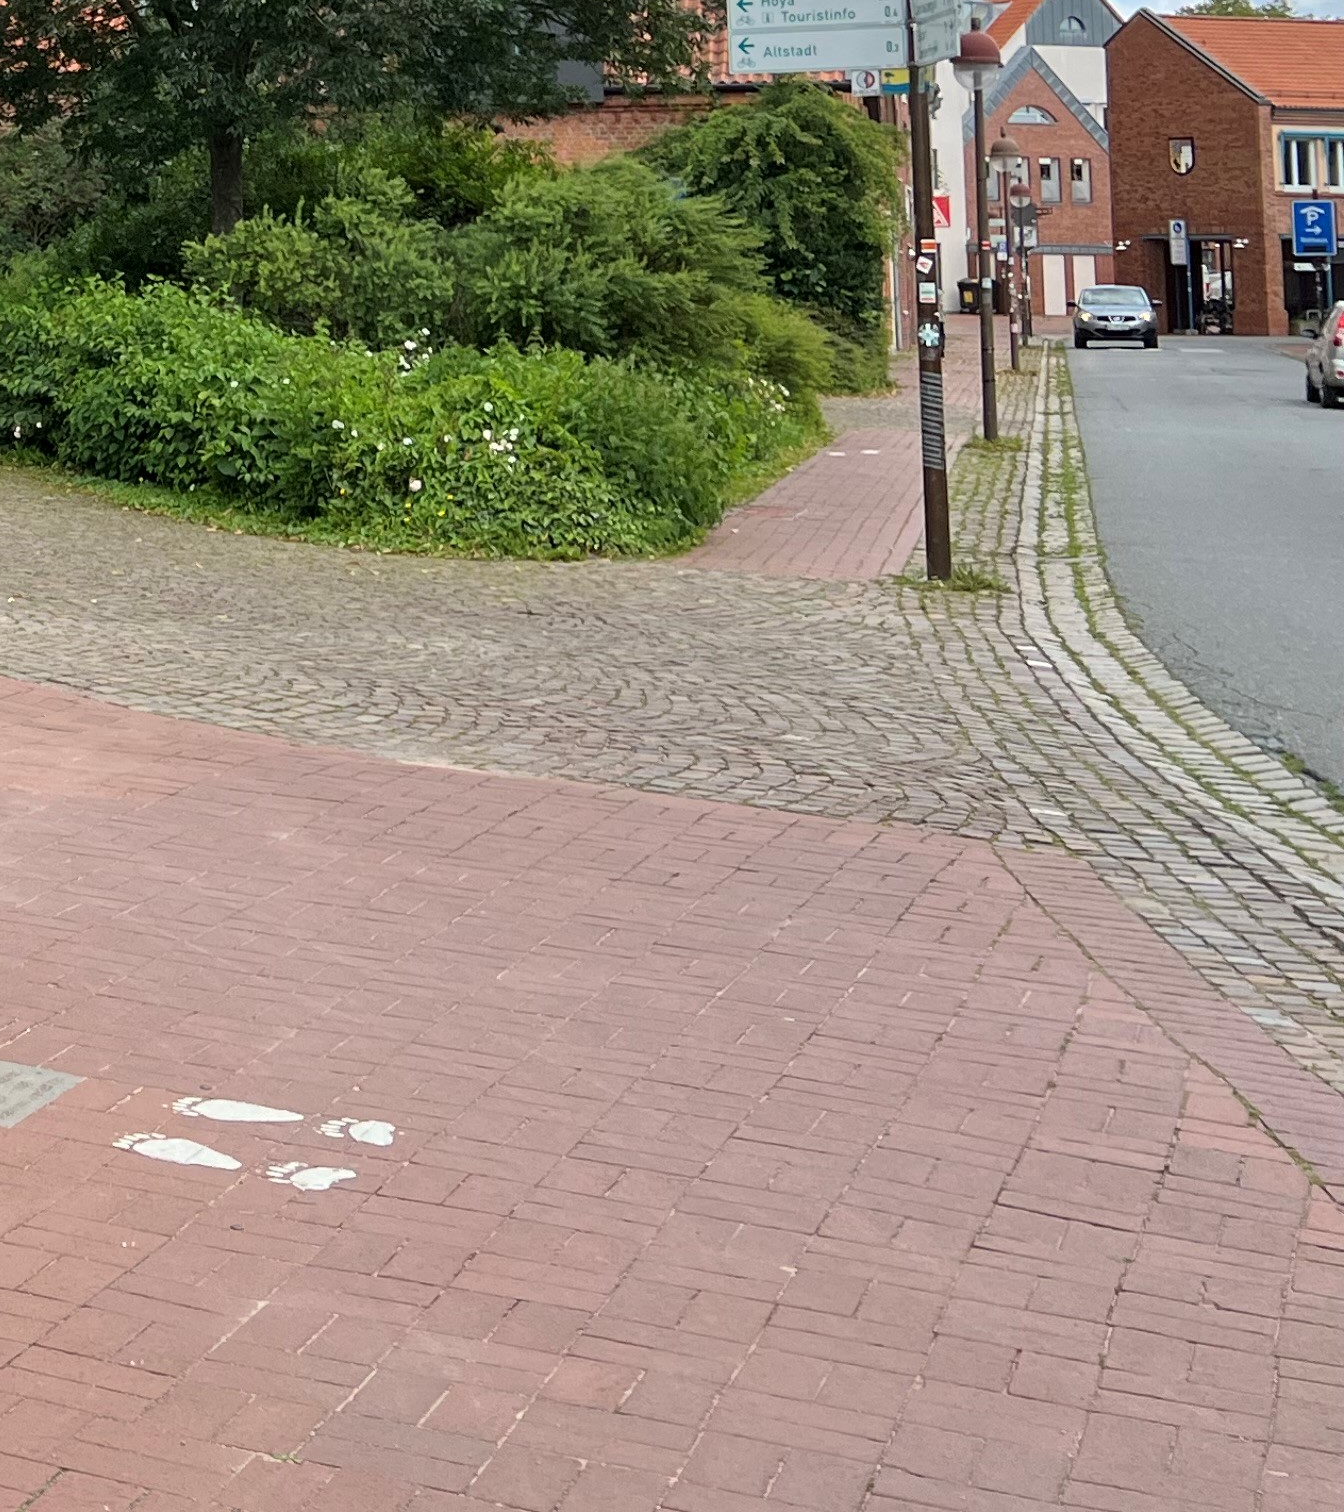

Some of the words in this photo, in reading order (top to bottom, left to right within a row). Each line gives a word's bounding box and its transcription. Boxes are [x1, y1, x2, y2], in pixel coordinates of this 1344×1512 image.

[781, 8, 856, 23] Touristinfo
[763, 44, 817, 58] Altstadt
[1306, 211, 1320, 226] P
